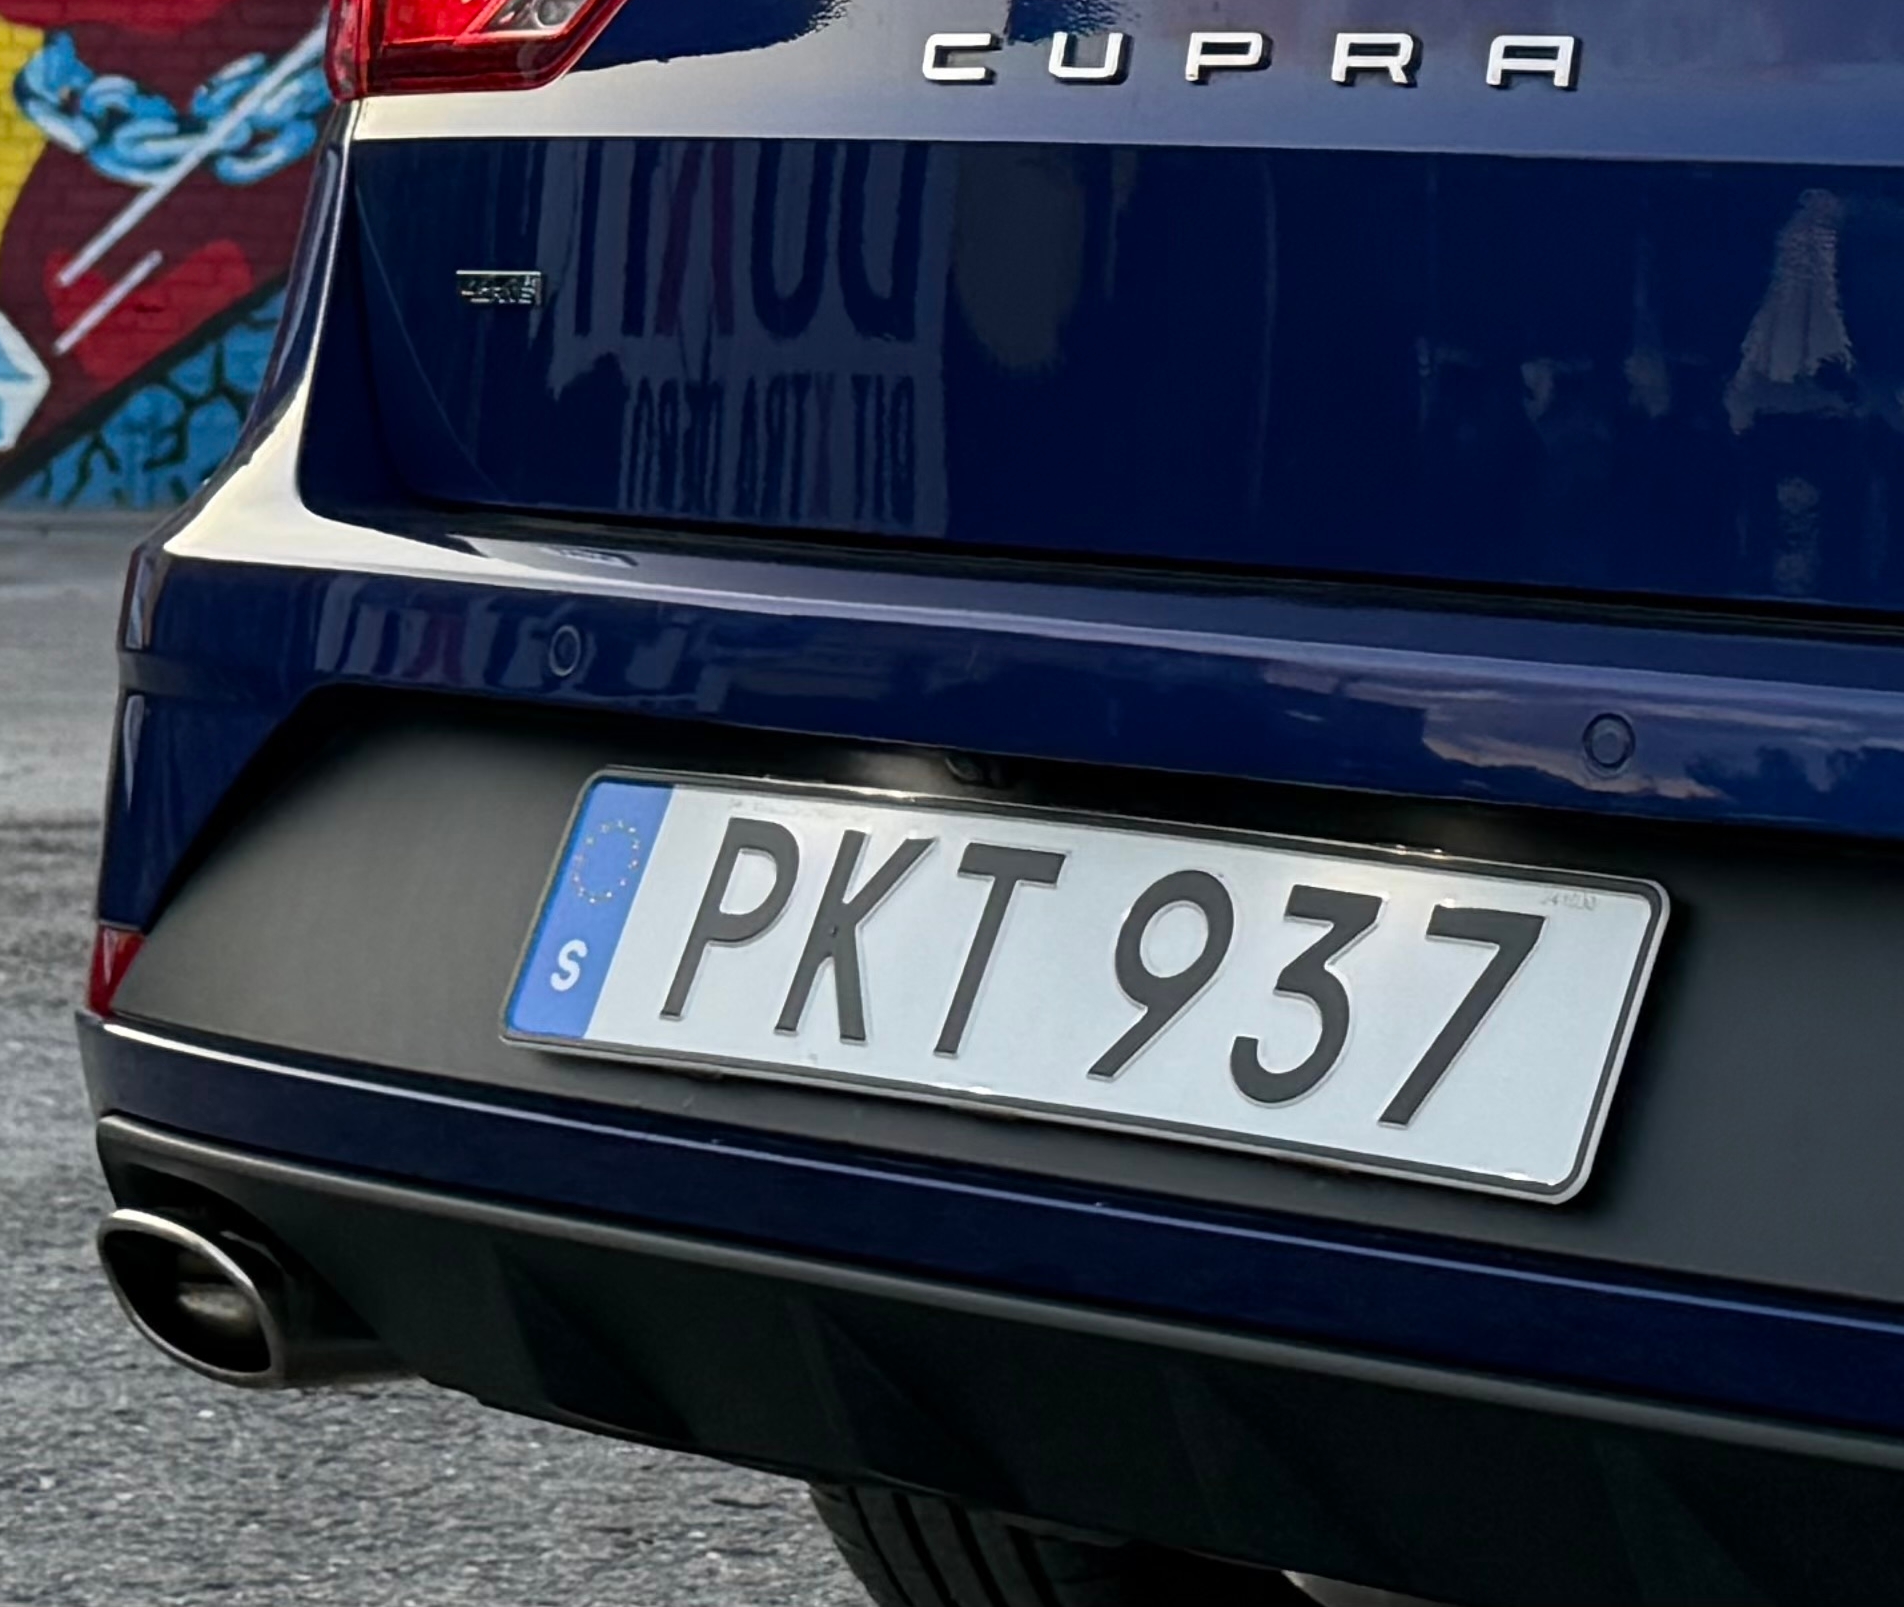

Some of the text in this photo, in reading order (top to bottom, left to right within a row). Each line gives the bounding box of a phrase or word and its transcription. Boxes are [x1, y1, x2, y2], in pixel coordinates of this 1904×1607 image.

[921, 31, 1580, 91] CUPRA
[550, 939, 587, 992] S
[659, 816, 1548, 1129] PKT 937
